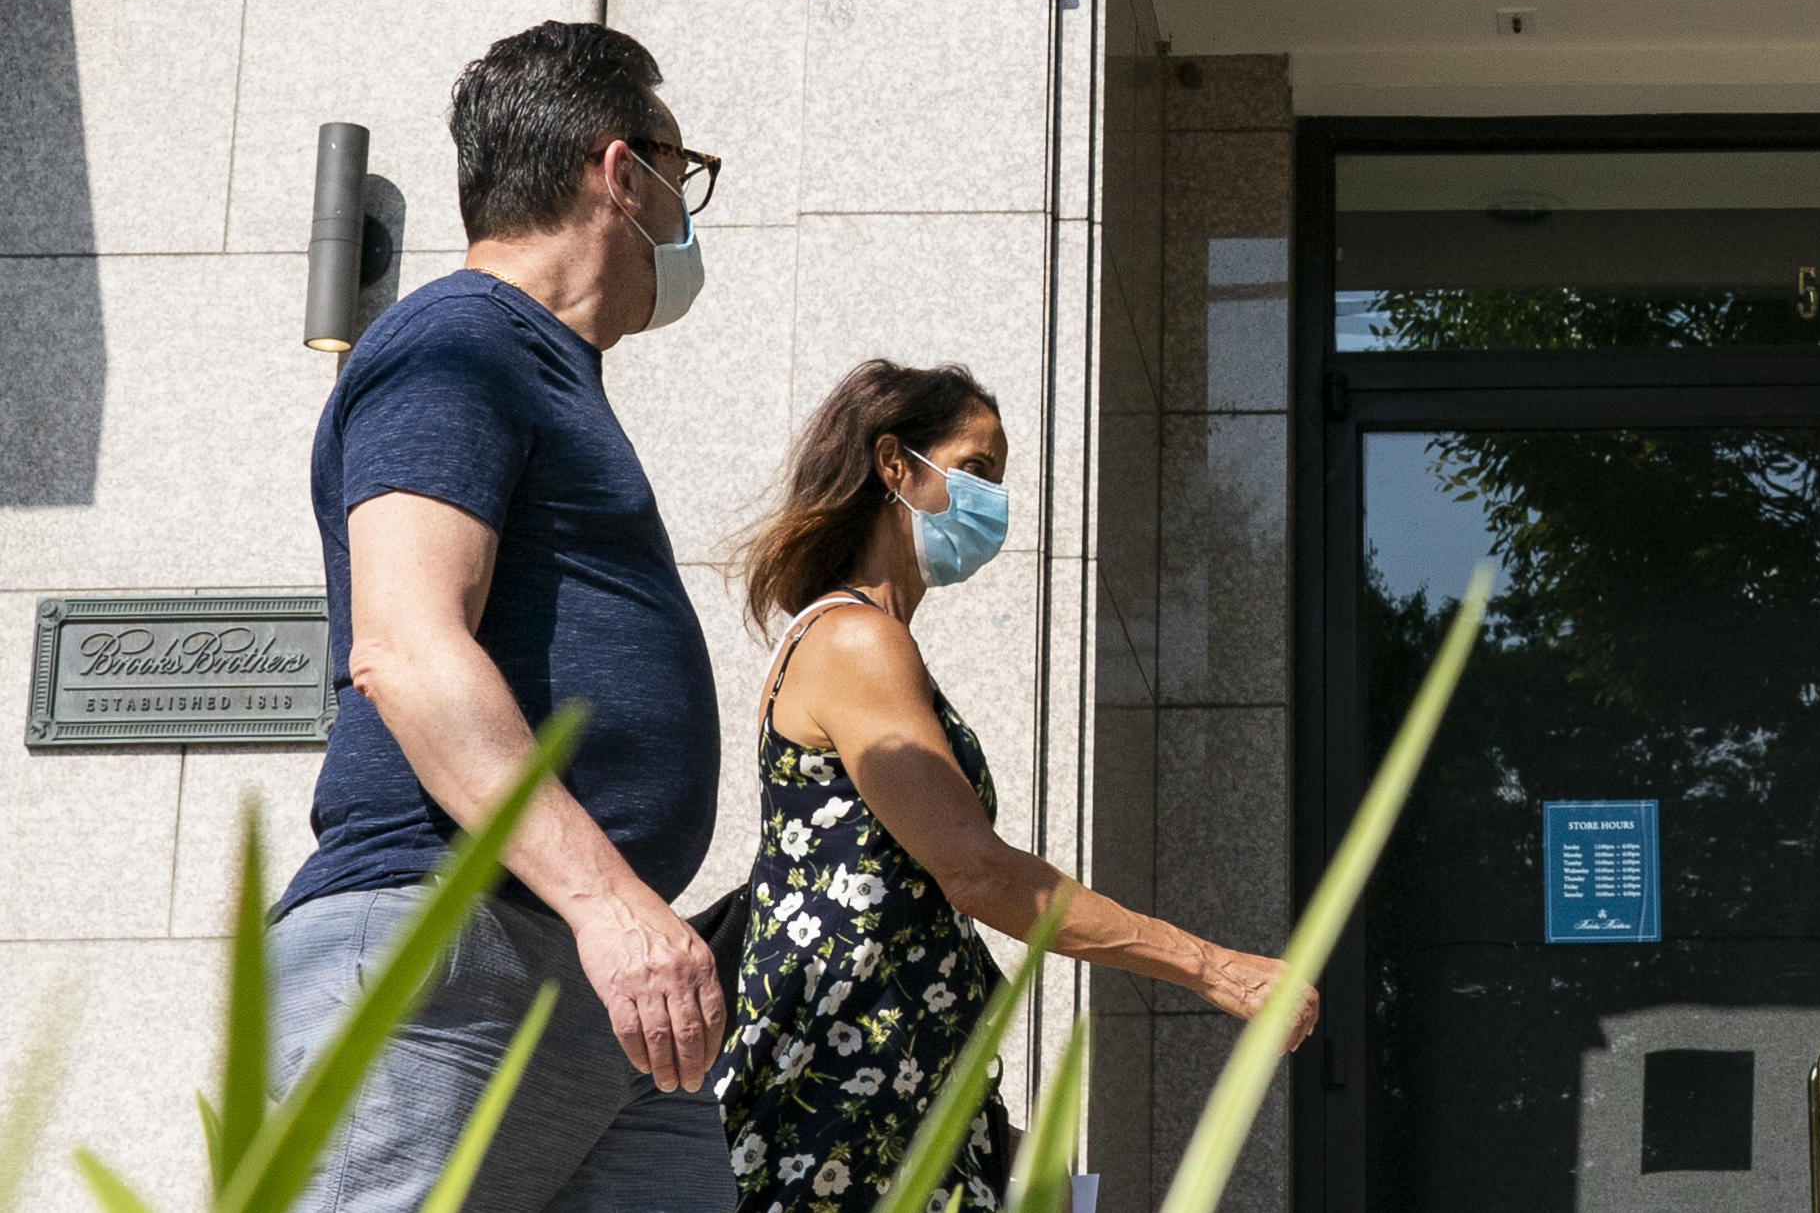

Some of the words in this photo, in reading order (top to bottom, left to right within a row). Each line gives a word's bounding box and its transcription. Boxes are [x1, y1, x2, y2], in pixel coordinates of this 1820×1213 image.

[80, 628, 183, 676] Brooks
[181, 627, 311, 674] Brothers
[85, 695, 231, 712] ESTABLISHED
[245, 694, 293, 710] 1818
[1568, 821, 1599, 830] STORE
[1601, 820, 1635, 830] HOURS
